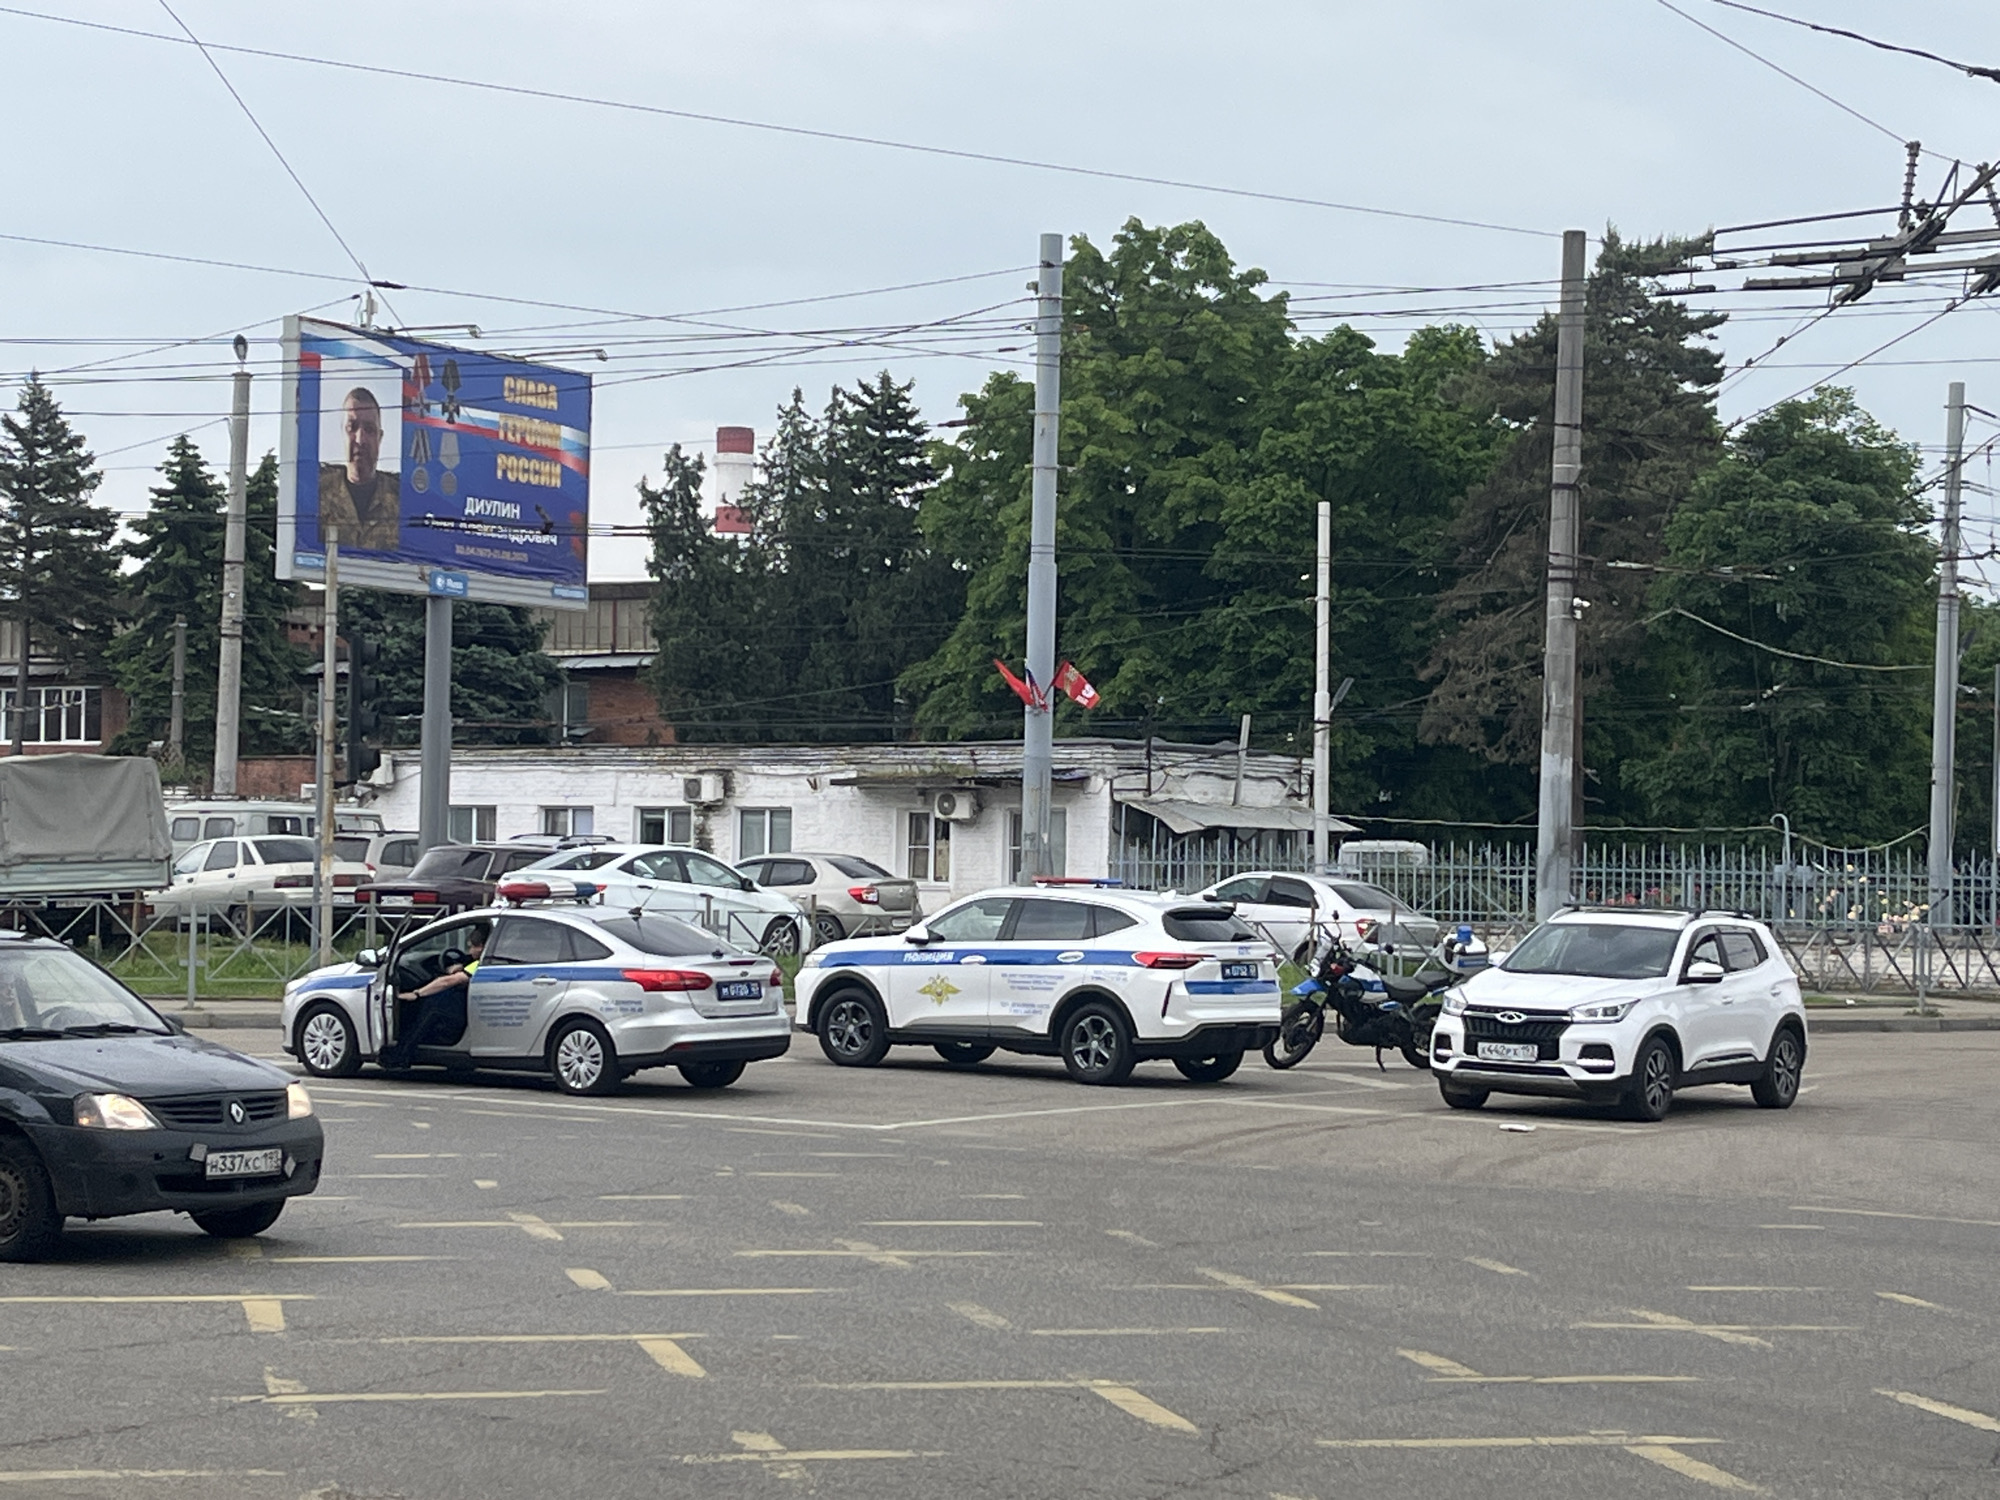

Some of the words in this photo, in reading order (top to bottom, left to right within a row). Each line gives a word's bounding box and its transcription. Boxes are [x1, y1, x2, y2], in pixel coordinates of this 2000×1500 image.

[503, 375, 558, 411] СЛАВА
[496, 452, 562, 488] РОССИИ
[464, 496, 520, 519] ДИУЛИН
[903, 951, 955, 963] ПОЛИЦИЯ
